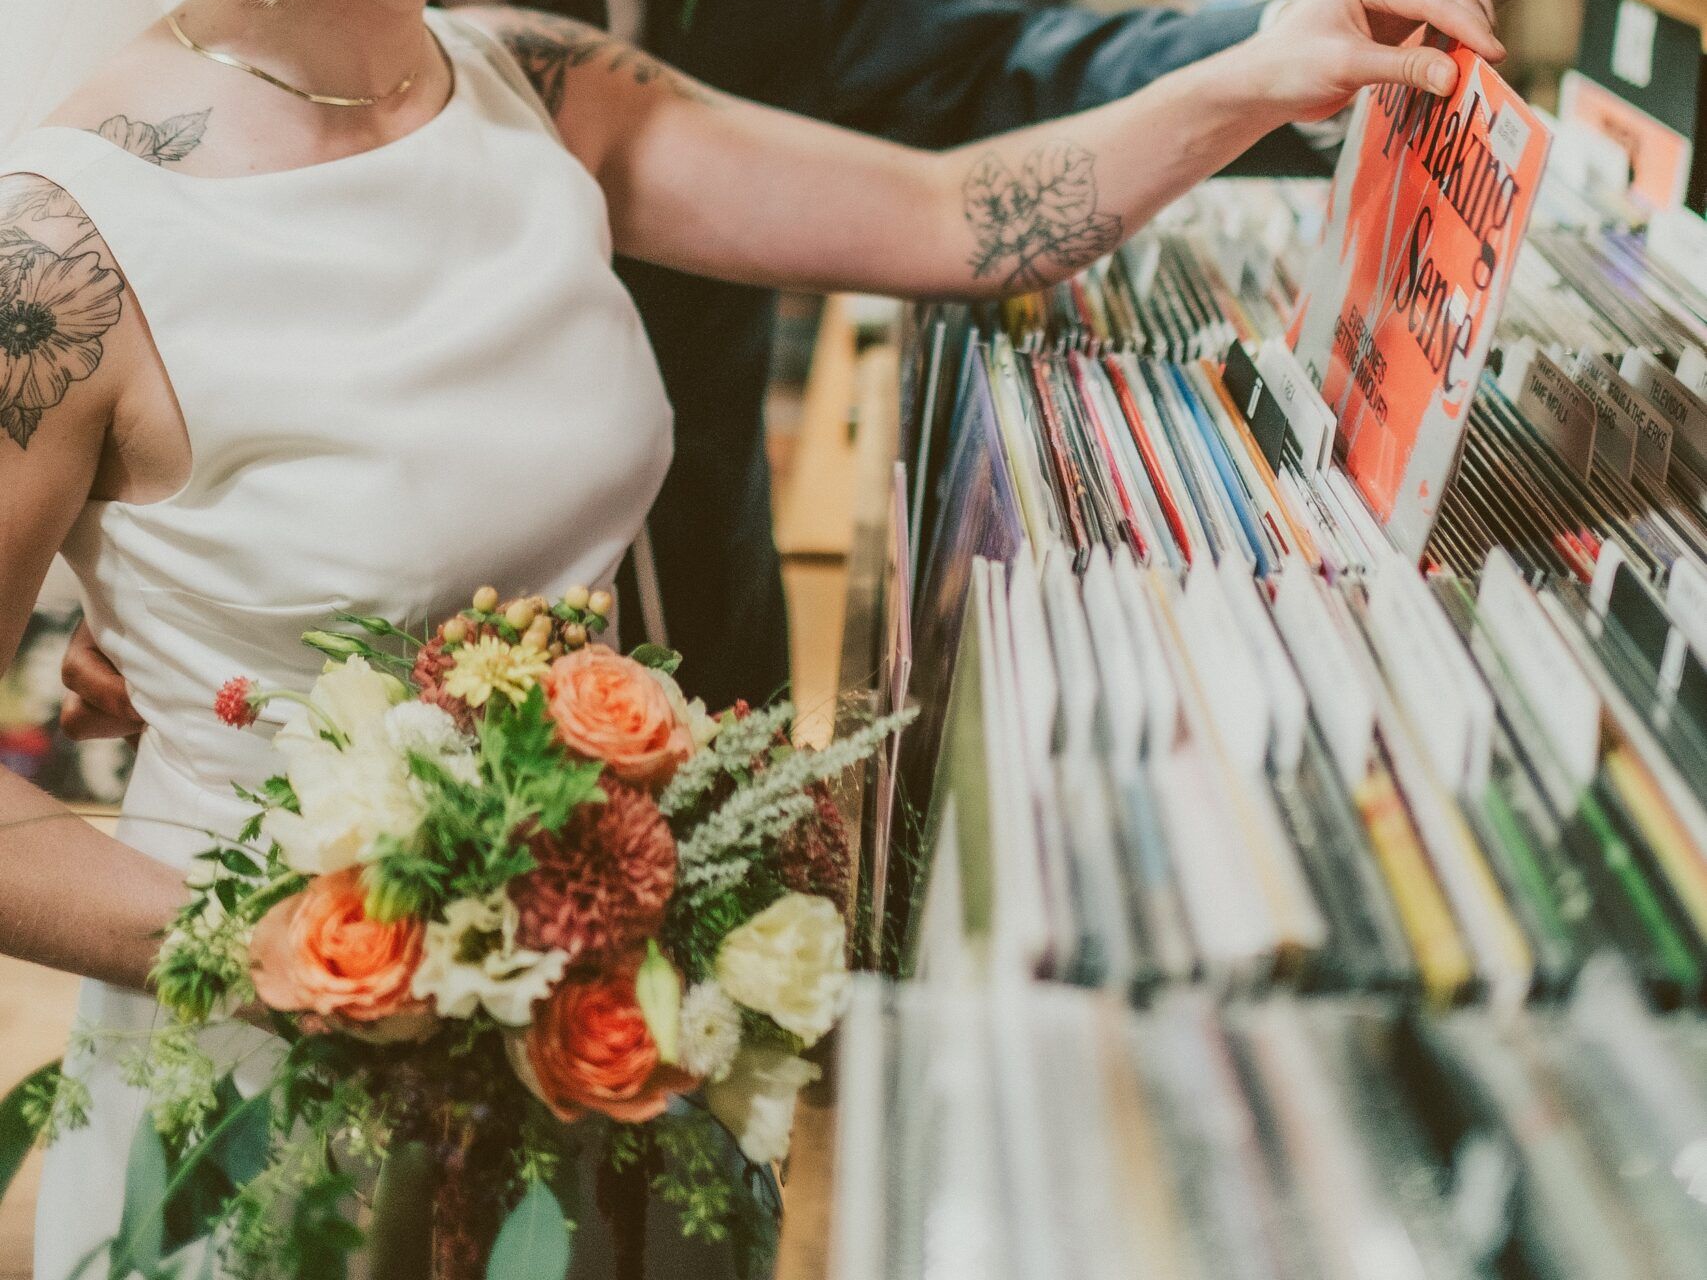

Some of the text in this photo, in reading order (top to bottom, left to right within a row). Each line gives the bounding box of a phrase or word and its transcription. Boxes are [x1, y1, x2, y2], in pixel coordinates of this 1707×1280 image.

[1407, 90, 1520, 290] Making
[1394, 206, 1473, 392] Sense
[1355, 356, 1388, 427] INVOLVED
[1631, 402, 1647, 429] THE
[1642, 417, 1668, 452] JERKS
[1649, 378, 1688, 425] TELEVISION
